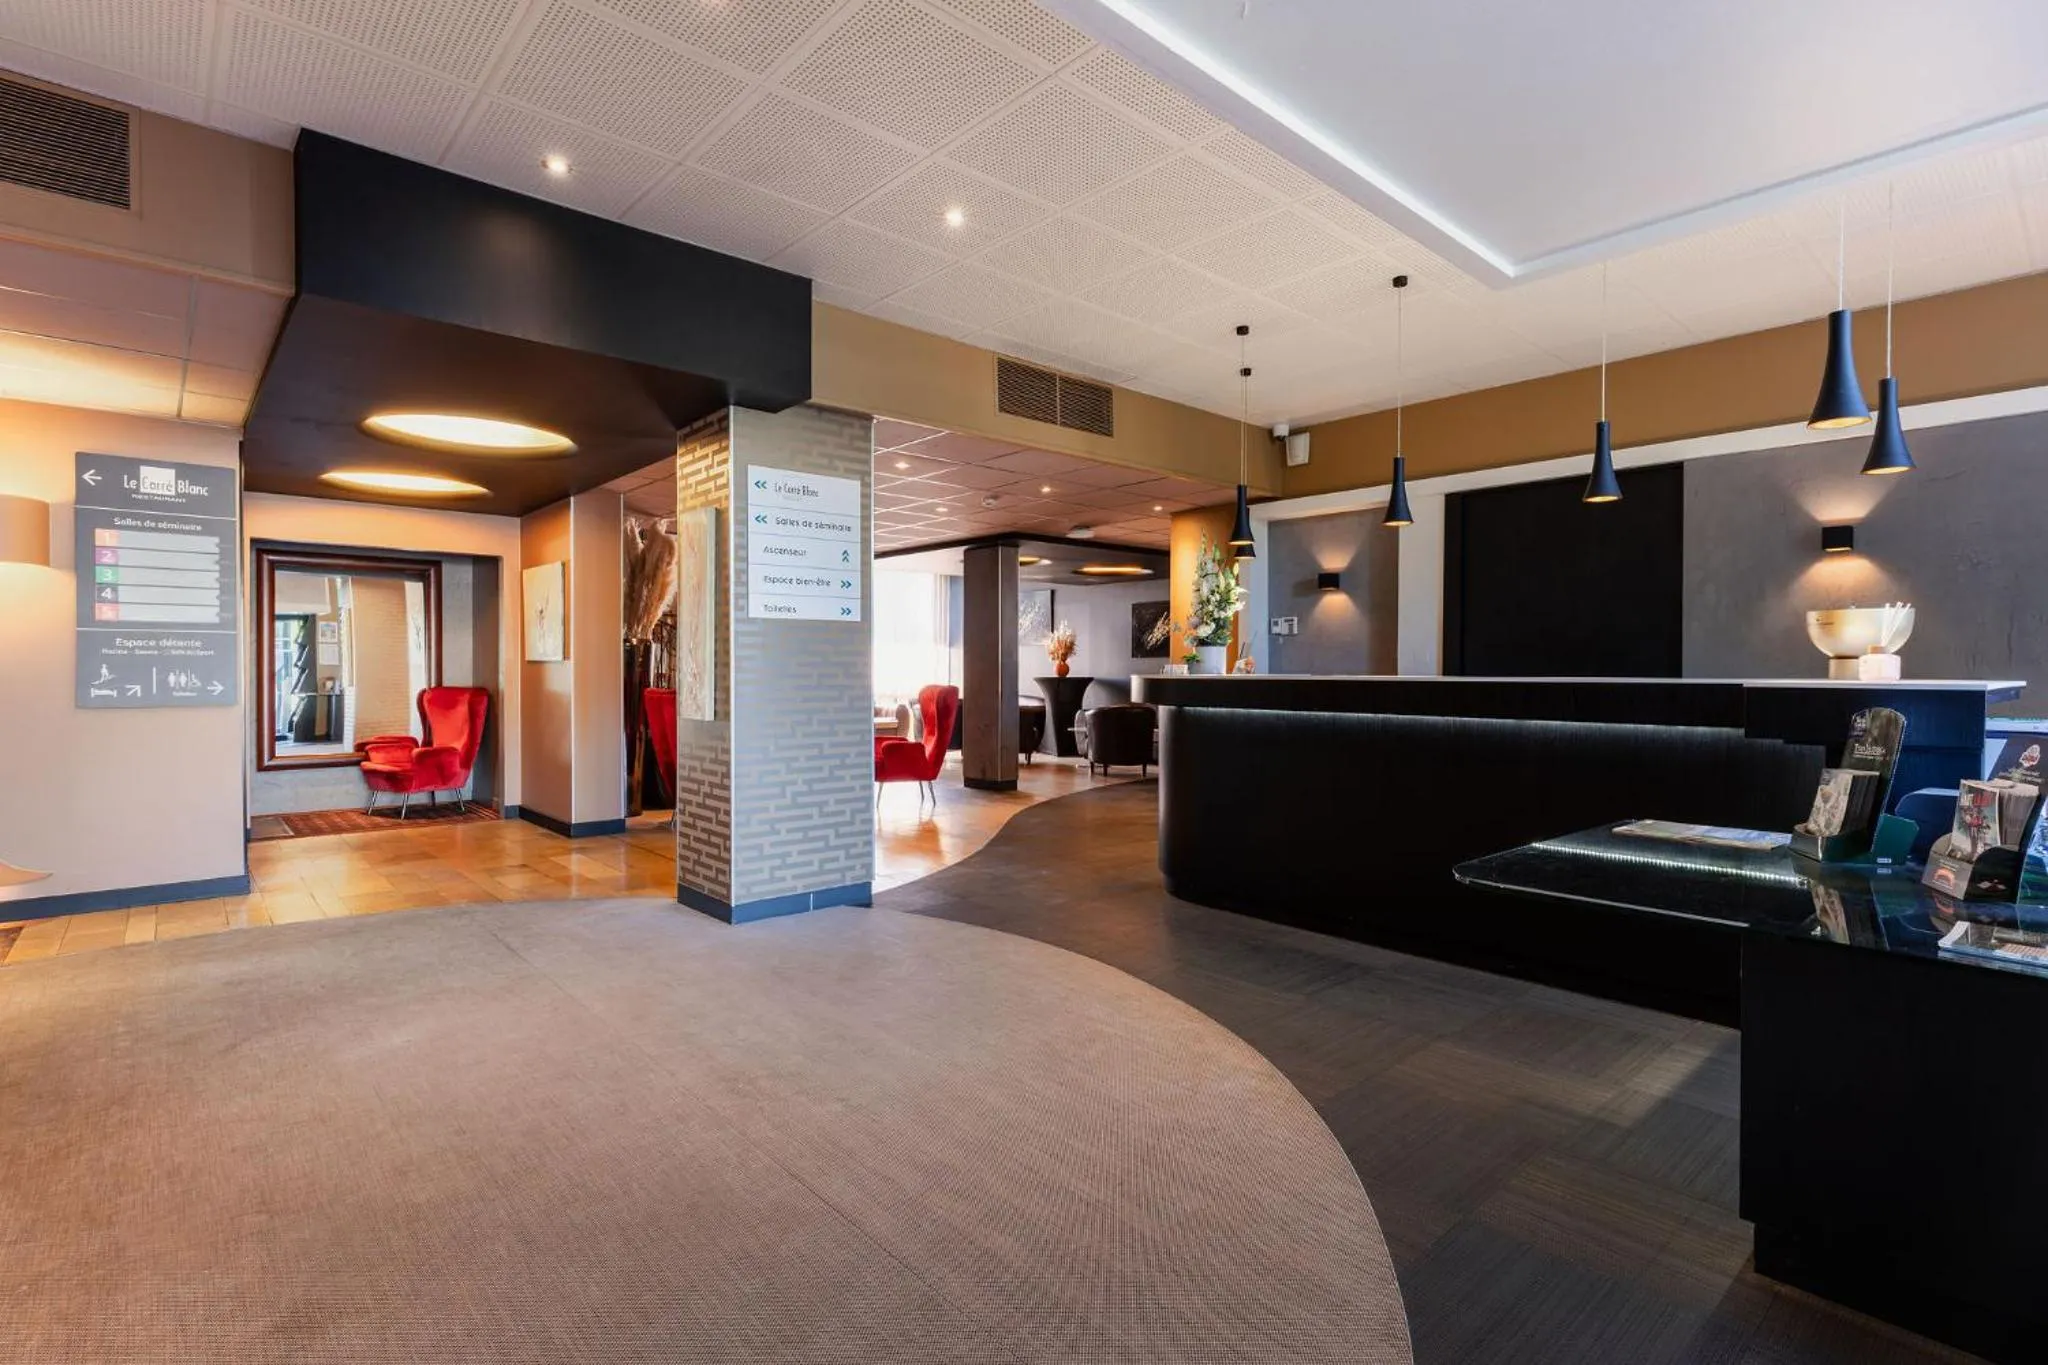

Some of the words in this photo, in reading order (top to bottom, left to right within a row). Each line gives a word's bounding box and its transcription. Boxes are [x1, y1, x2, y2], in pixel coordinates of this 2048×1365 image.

[123, 474, 138, 489] Le
[775, 482, 782, 493] Le
[113, 516, 143, 527] Salles
[144, 519, 157, 528] de
[158, 521, 203, 531] séminaire
[776, 516, 800, 527] Salles
[802, 520, 813, 529] de
[814, 522, 852, 533] séminaire
[101, 550, 112, 562] 2
[763, 546, 807, 556] Ascenseur
[103, 568, 113, 580] 3
[764, 575, 794, 585] Espace
[795, 576, 831, 587] bien-être
[101, 587, 112, 600] 4
[115, 638, 156, 648] Espace
[158, 638, 202, 648] détente
